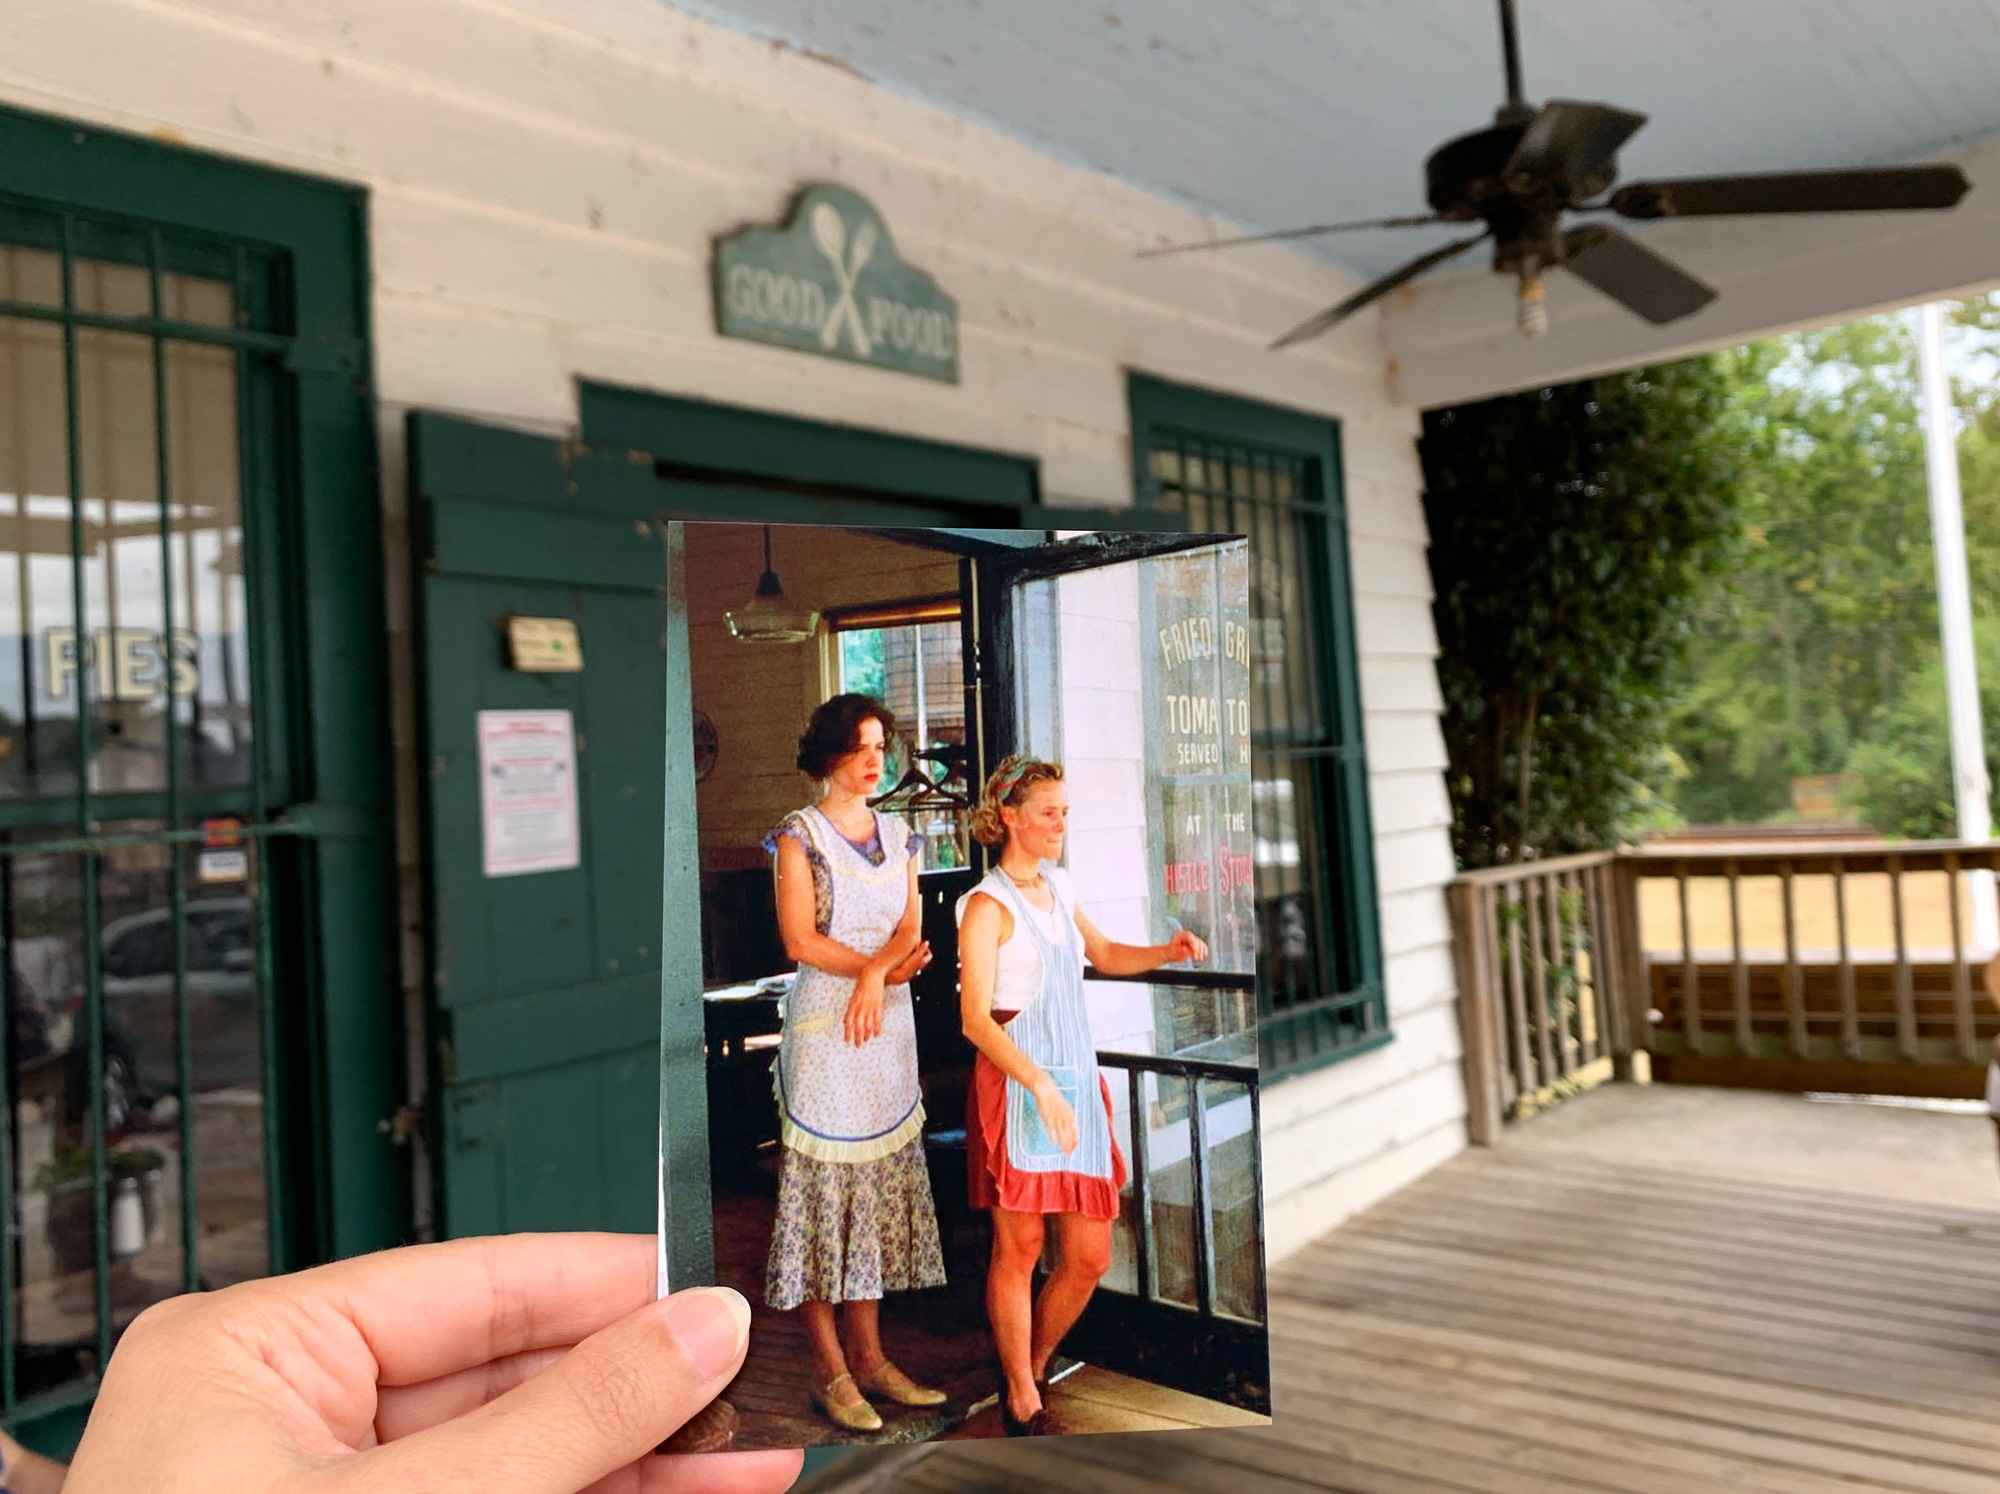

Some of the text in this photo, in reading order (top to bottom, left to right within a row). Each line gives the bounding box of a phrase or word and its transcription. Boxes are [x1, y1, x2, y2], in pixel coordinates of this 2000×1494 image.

[727, 264, 826, 331] GOOD
[46, 627, 199, 699] PIES
[1159, 616, 1212, 671] FRIED
[1177, 743, 1219, 766] SERVED
[1186, 812, 1246, 836] AT THE
